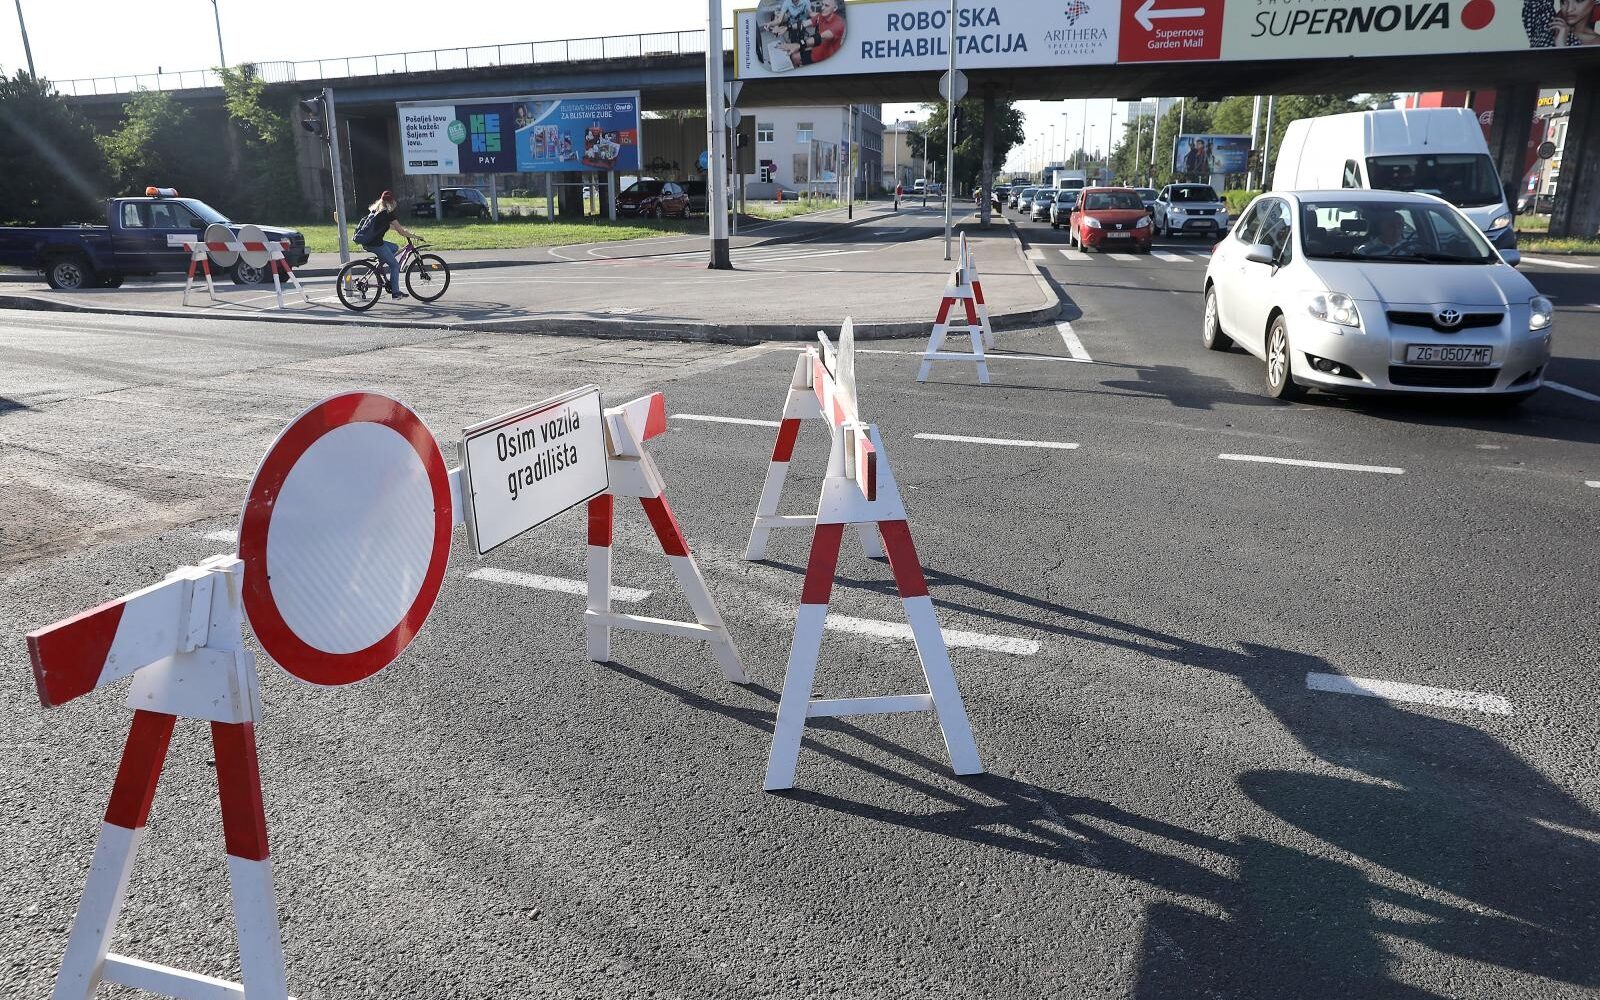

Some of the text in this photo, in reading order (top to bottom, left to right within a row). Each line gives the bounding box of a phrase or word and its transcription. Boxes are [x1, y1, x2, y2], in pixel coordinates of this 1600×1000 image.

[887, 7, 1000, 32] ROBOSKA
[1251, 2, 1450, 37] SUPERNOVA
[1044, 28, 1108, 41] ARITHERA
[1155, 29, 1204, 39] Supernova
[1147, 38, 1204, 49] Garden Mall
[570, 111, 596, 119] BLISTAVE
[597, 110, 613, 118] ZUBE
[406, 131, 428, 139] Šaljem
[479, 156, 496, 164] PAY
[1417, 347, 1432, 360] ZG
[496, 407, 580, 462] Osim vozila
[508, 443, 578, 501] gradilišta
